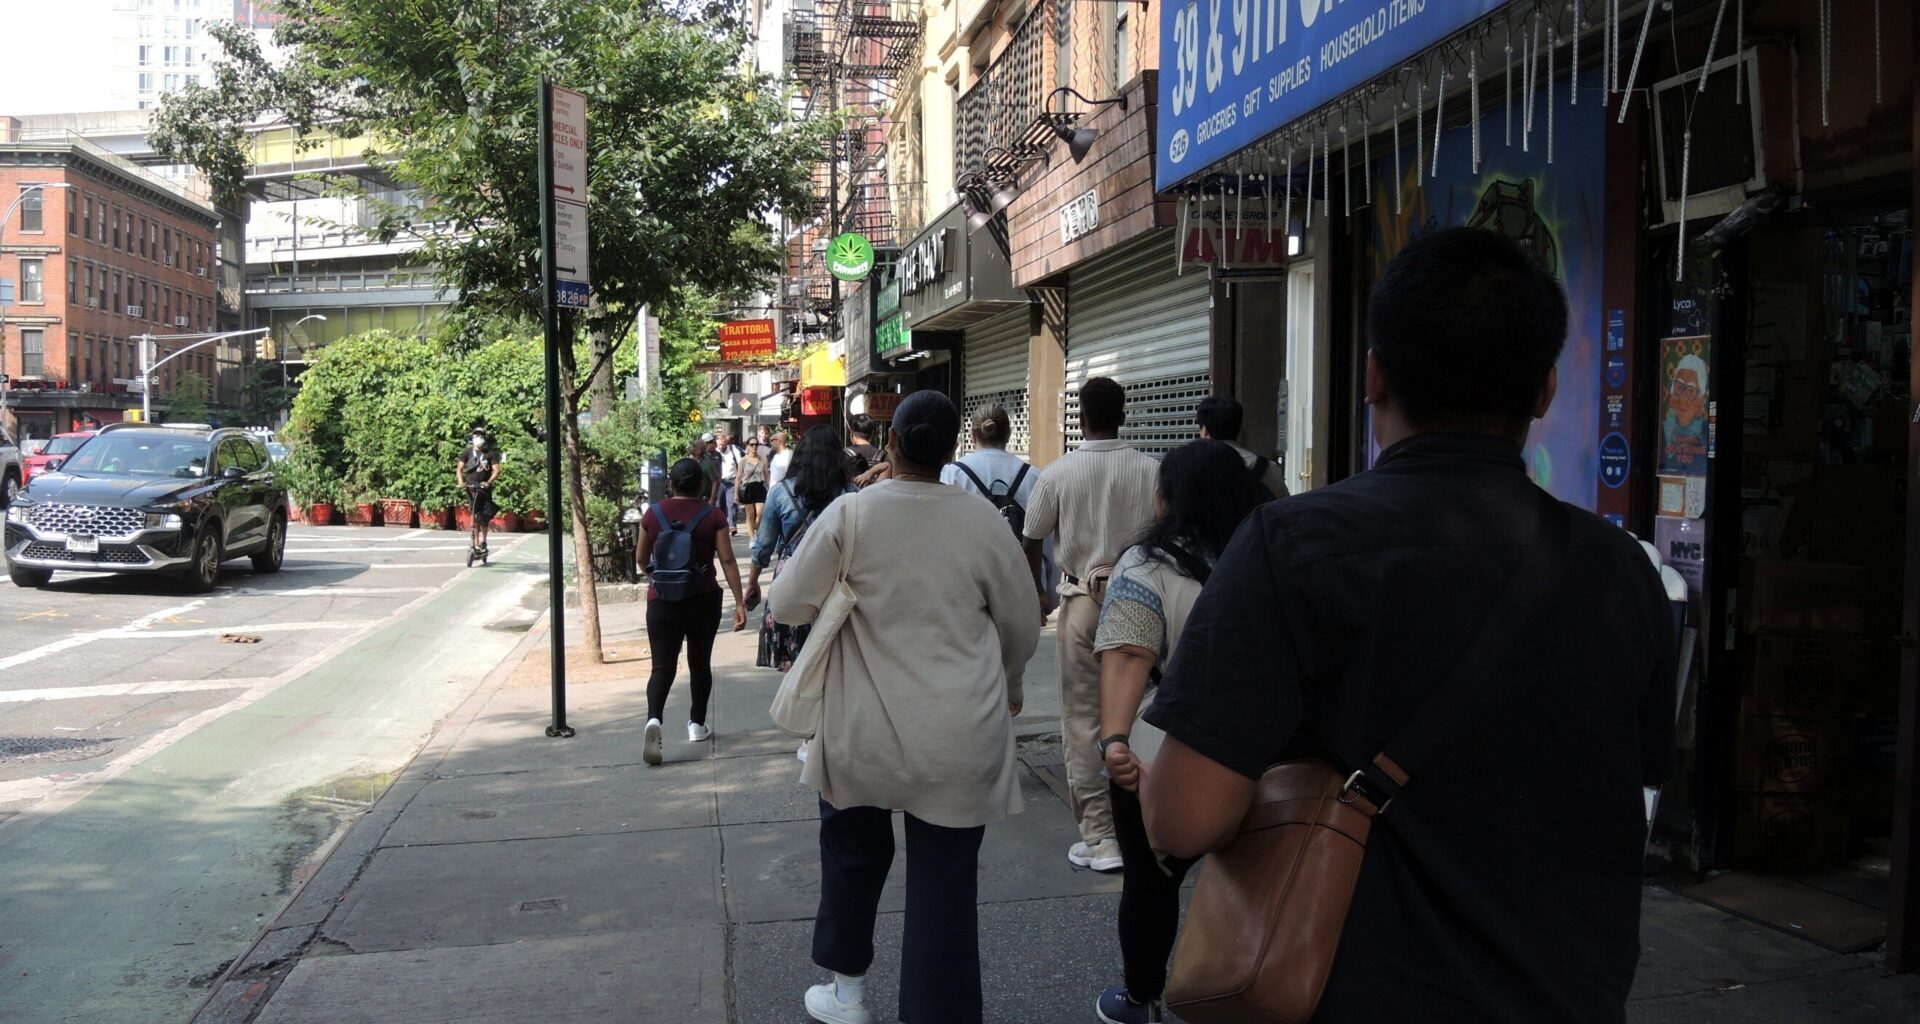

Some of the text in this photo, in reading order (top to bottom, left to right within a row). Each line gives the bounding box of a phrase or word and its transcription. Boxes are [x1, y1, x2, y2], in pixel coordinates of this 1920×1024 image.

[1172, 8, 1198, 116] 39
[1206, 0, 1224, 94] &
[1197, 102, 1237, 145] GROCERIES
[1243, 86, 1262, 119] GIFT
[1268, 55, 1311, 103] SUPPLIES
[1320, 12, 1386, 72] HOUSEHOLD
[1388, 0, 1426, 32] ITEMS
[570, 137, 584, 150] ONLY
[1171, 135, 1188, 158] 526
[1182, 227, 1285, 263] ATM
[1673, 298, 1691, 311] Lyca
[724, 323, 771, 336] TRATTORIA
[724, 337, 772, 347] CASA DI ISACCO
[1670, 541, 1701, 560] NYC
